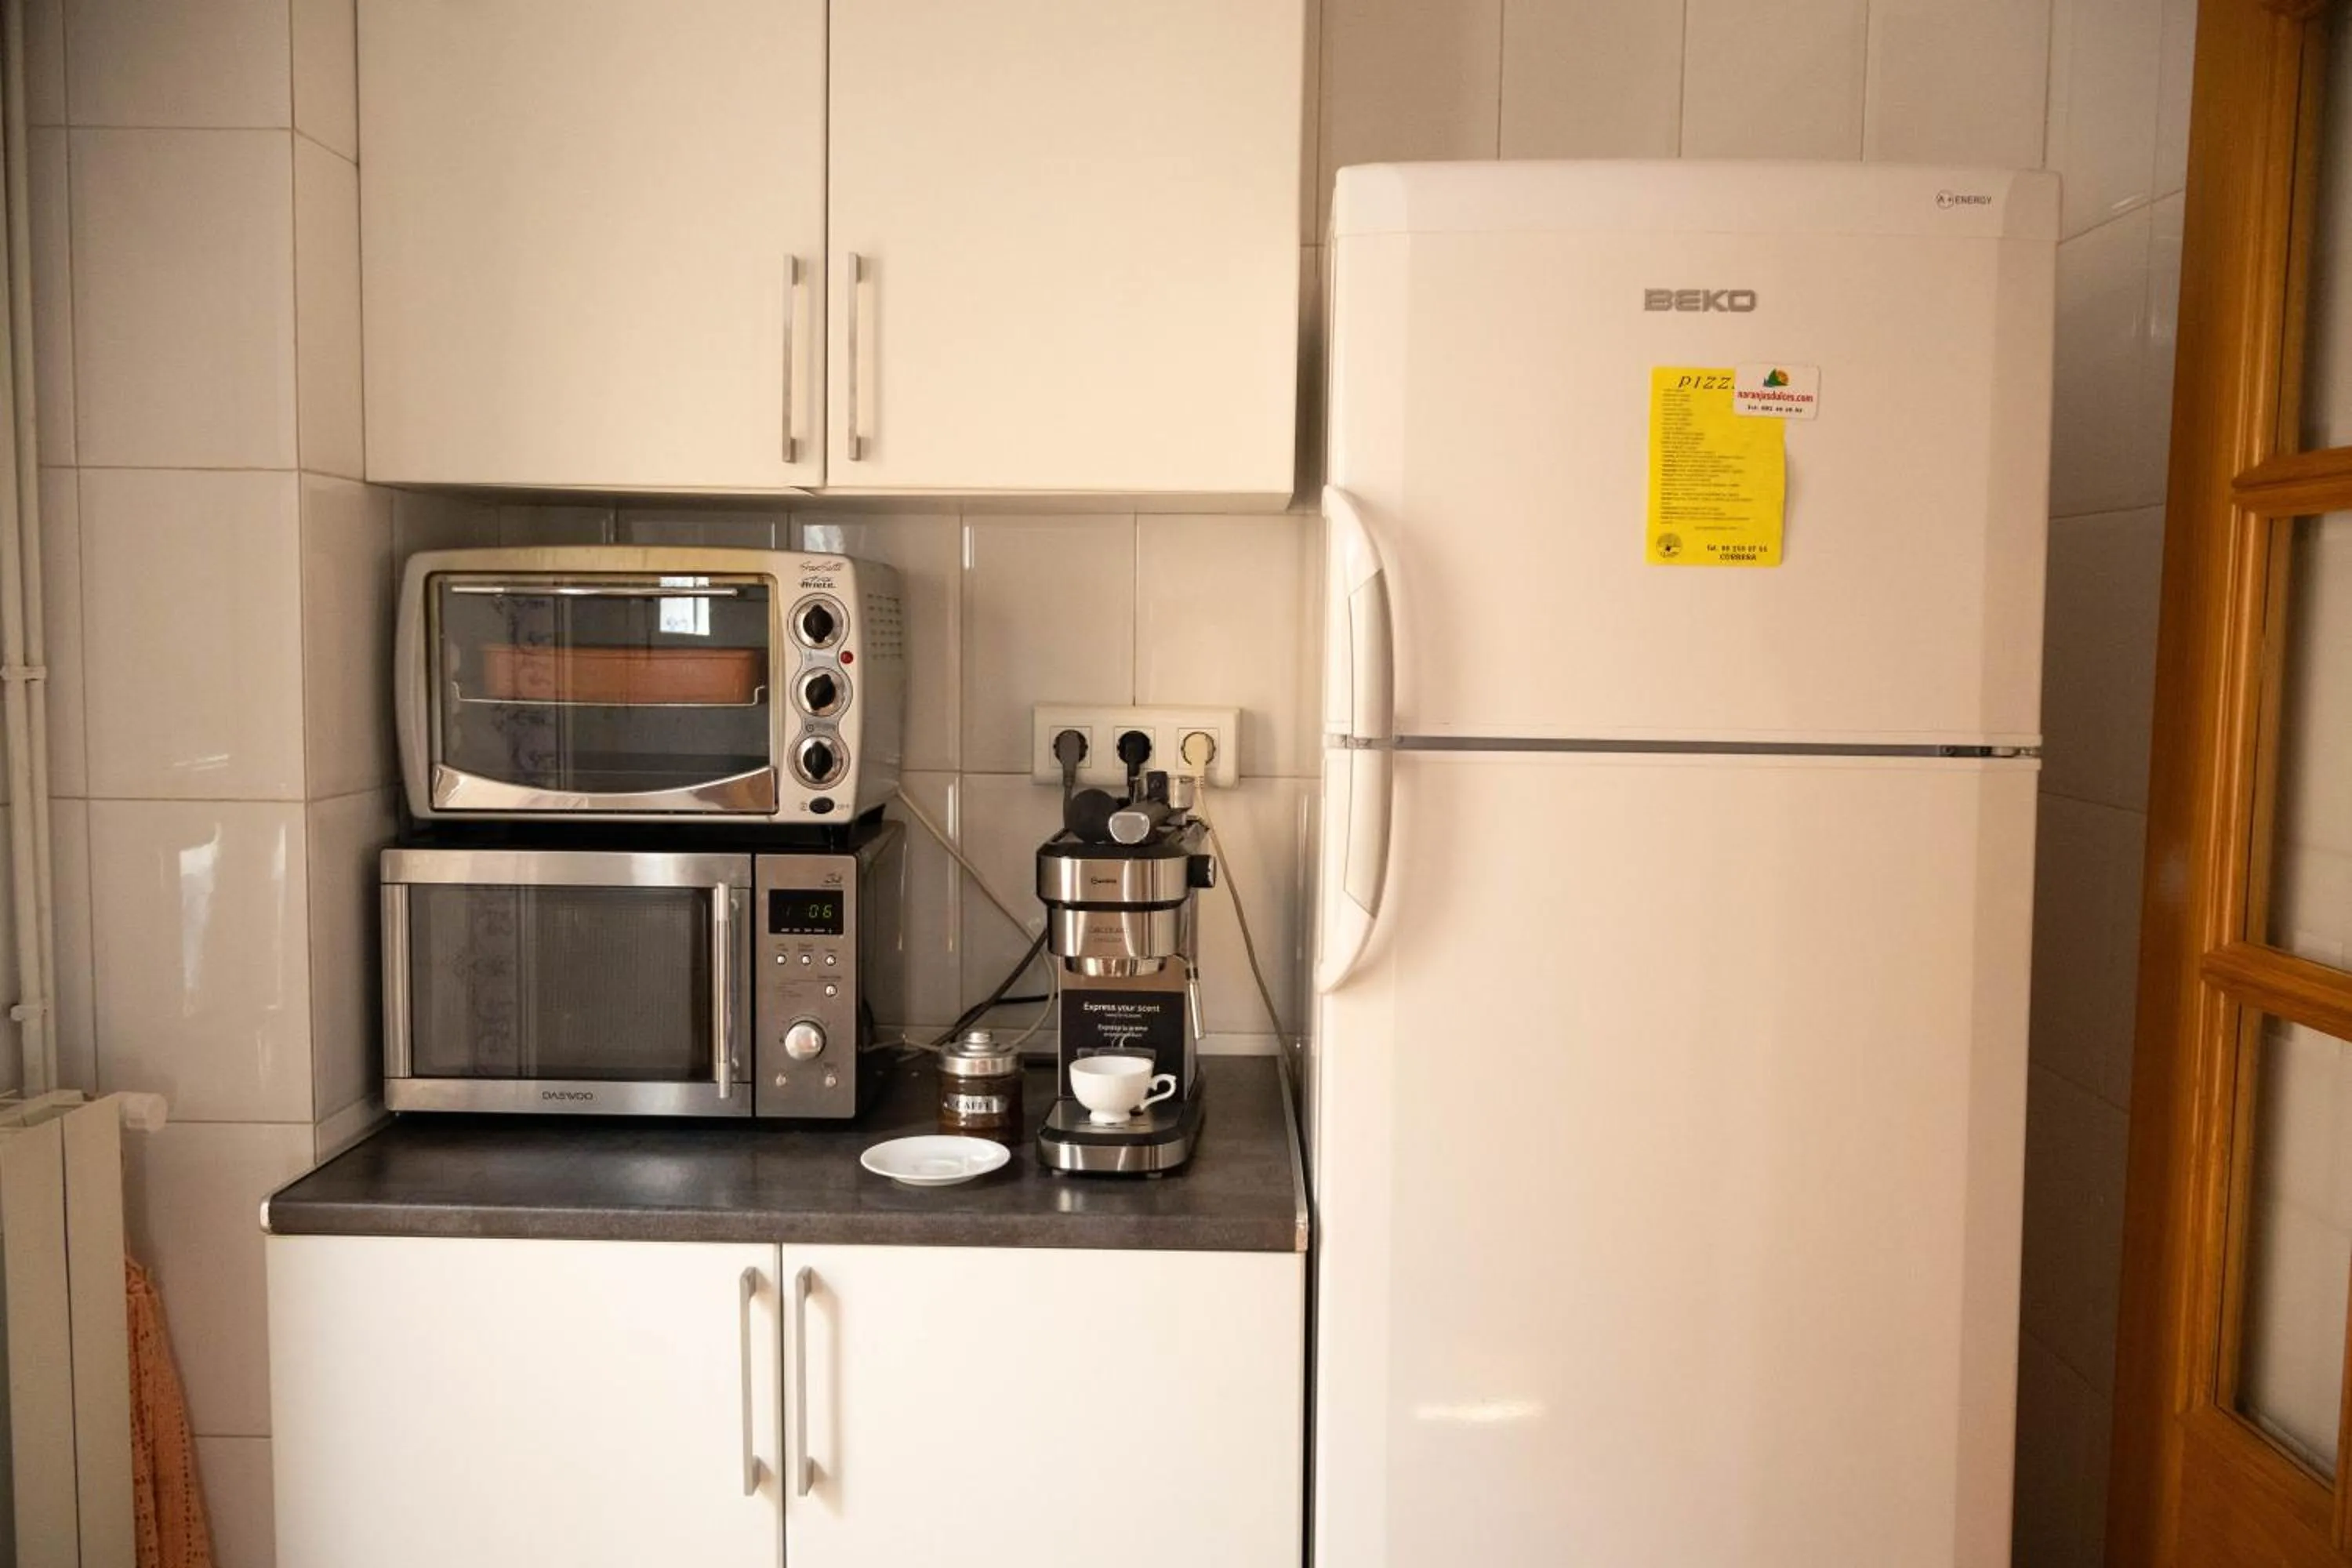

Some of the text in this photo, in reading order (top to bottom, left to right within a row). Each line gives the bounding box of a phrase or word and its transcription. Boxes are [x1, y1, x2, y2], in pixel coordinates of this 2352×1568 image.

[1955, 194, 1992, 205] ENERGY
[1644, 289, 1756, 312] BEKO
[1679, 376, 1734, 389] PIZZ
[1083, 1002, 1116, 1012] Express
[542, 1091, 593, 1100] DAEWOO
